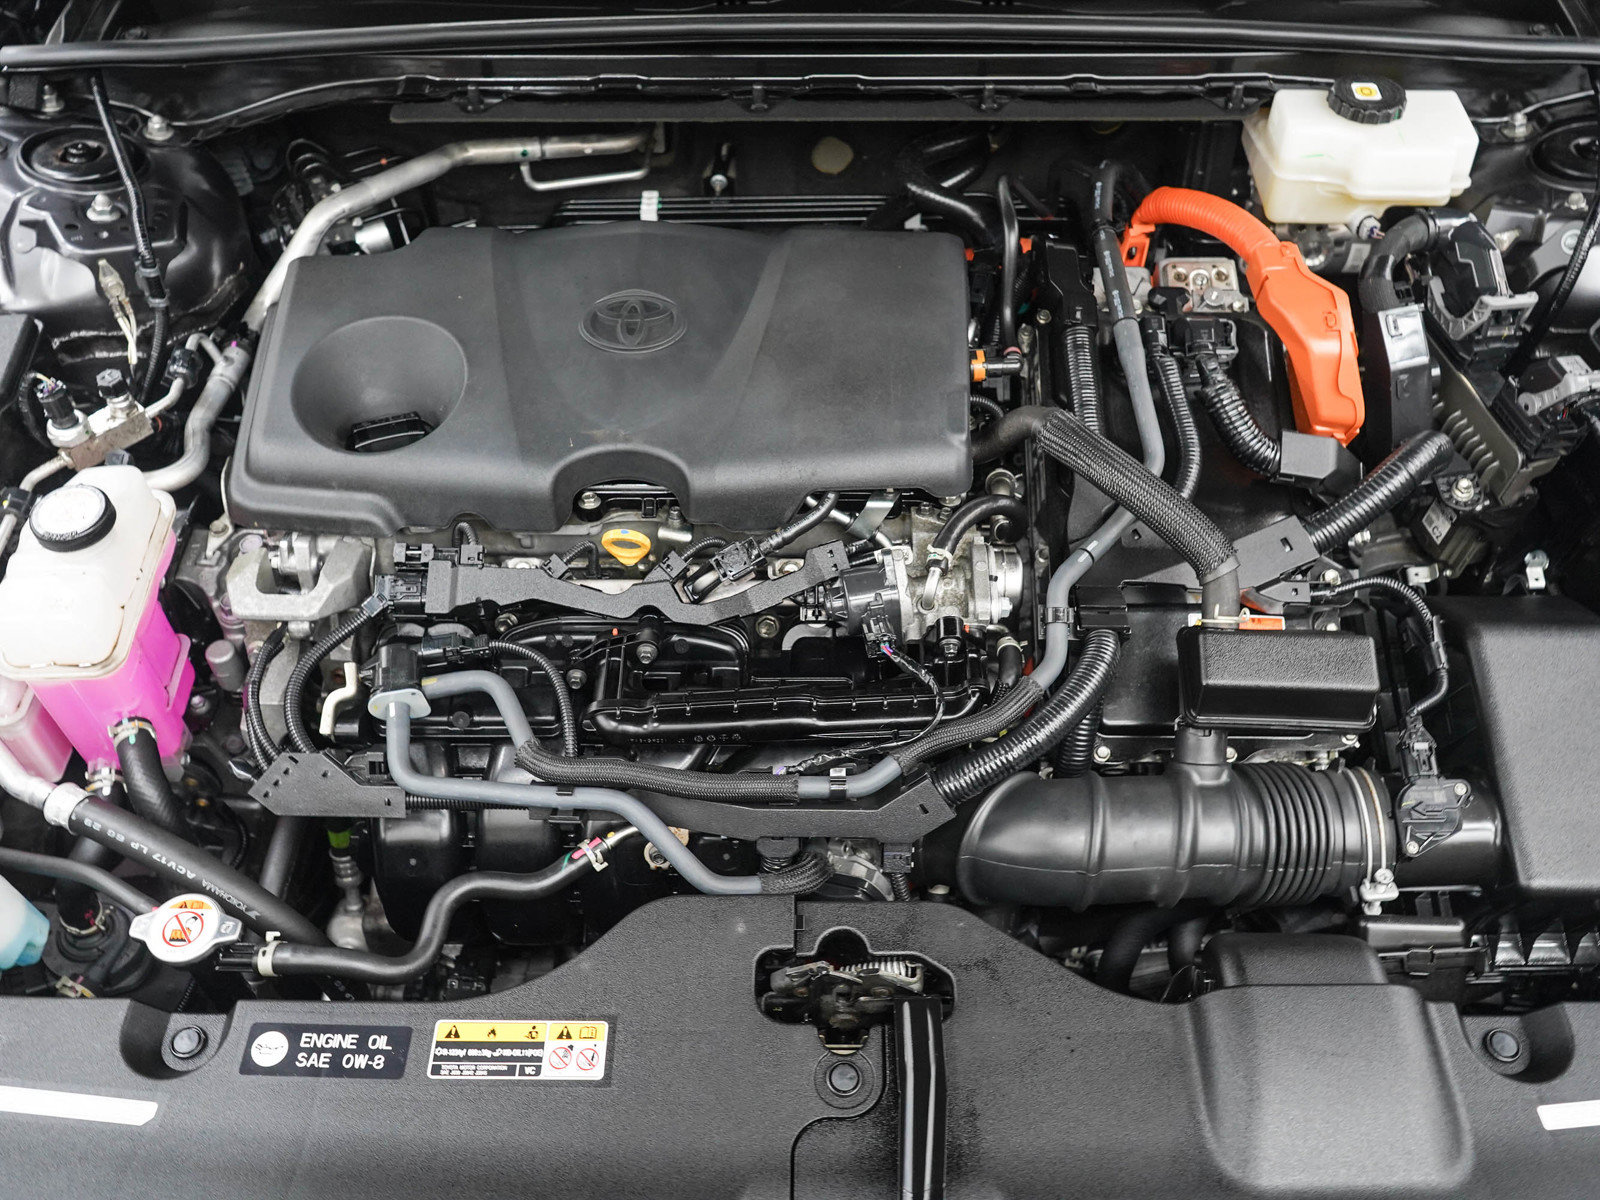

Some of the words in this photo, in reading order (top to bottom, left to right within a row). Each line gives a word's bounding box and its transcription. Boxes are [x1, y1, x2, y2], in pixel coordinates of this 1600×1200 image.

[130, 841, 149, 855] LP
[152, 852, 197, 879] ACV17
[202, 879, 247, 912] YOKOHAMA
[299, 1032, 360, 1050] ENGINE
[367, 1034, 393, 1051] OIL
[295, 1052, 333, 1069] SAE
[341, 1053, 386, 1070] 0W-8
